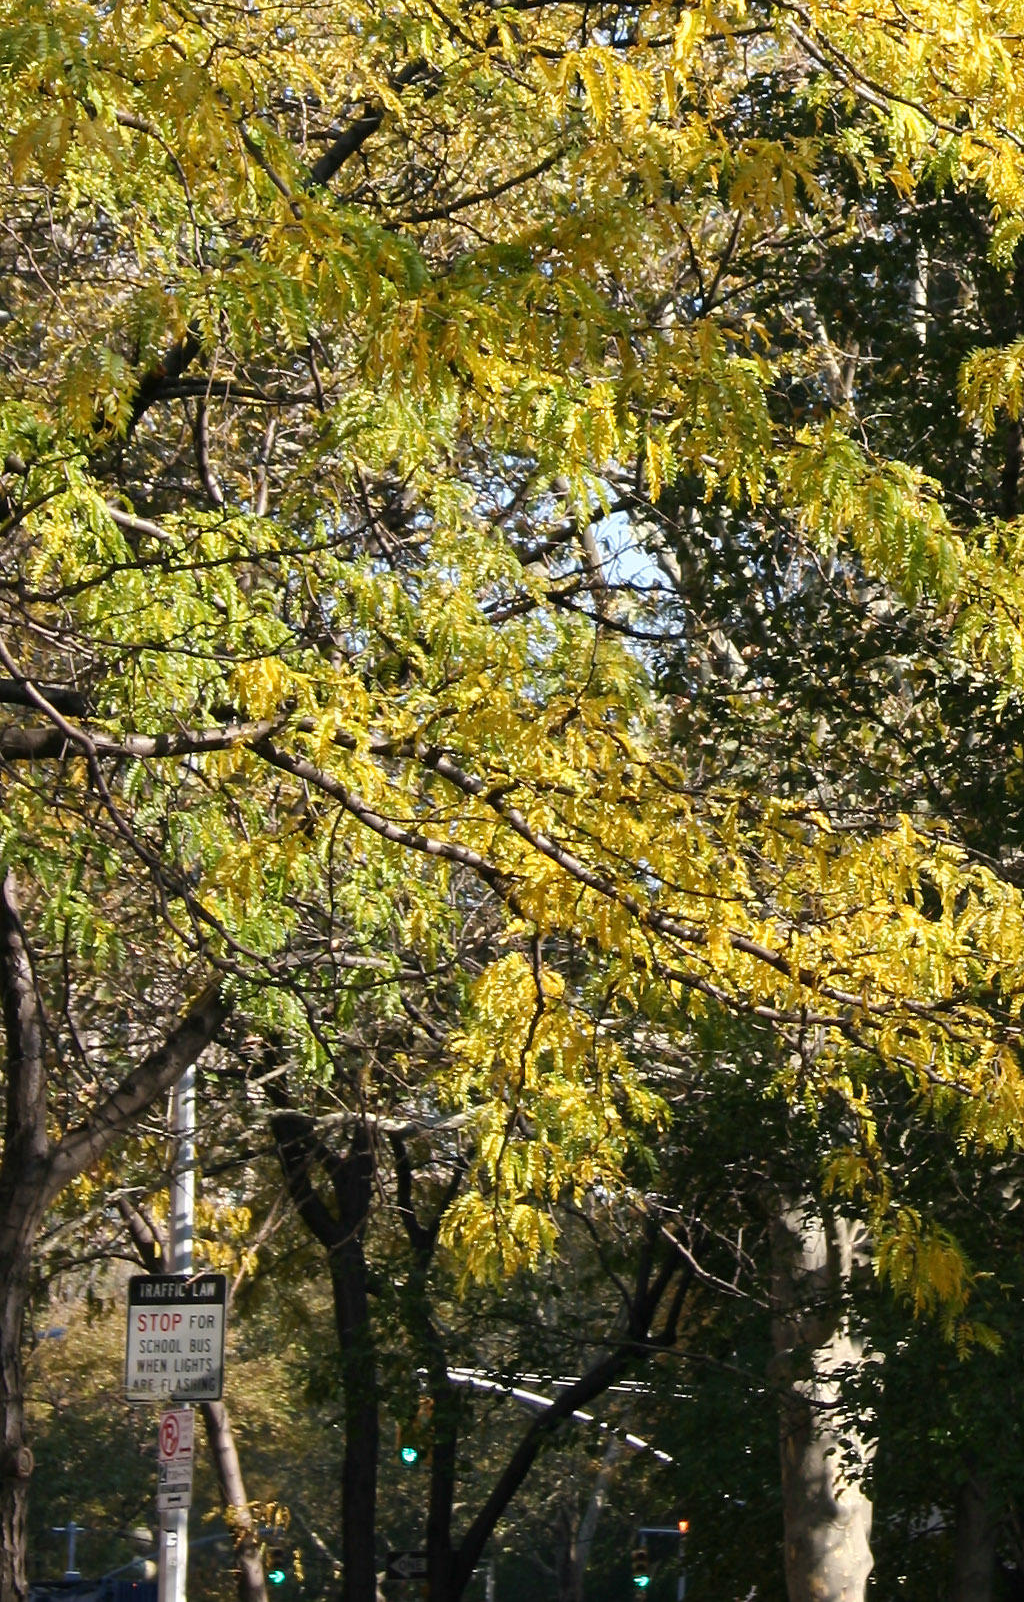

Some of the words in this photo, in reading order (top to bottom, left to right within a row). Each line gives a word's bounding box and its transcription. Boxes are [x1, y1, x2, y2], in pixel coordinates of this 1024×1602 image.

[141, 1283, 185, 1297] TRAFFIC
[193, 1283, 215, 1297] LAW
[138, 1313, 182, 1332] STOP
[189, 1315, 215, 1329] FOR
[139, 1339, 182, 1353] SCHOOL
[190, 1338, 211, 1353] BUS
[137, 1359, 167, 1373] WHEN
[174, 1358, 212, 1373] LIGHTS
[133, 1378, 155, 1392] ARE
[162, 1377, 216, 1392] FLASHING
